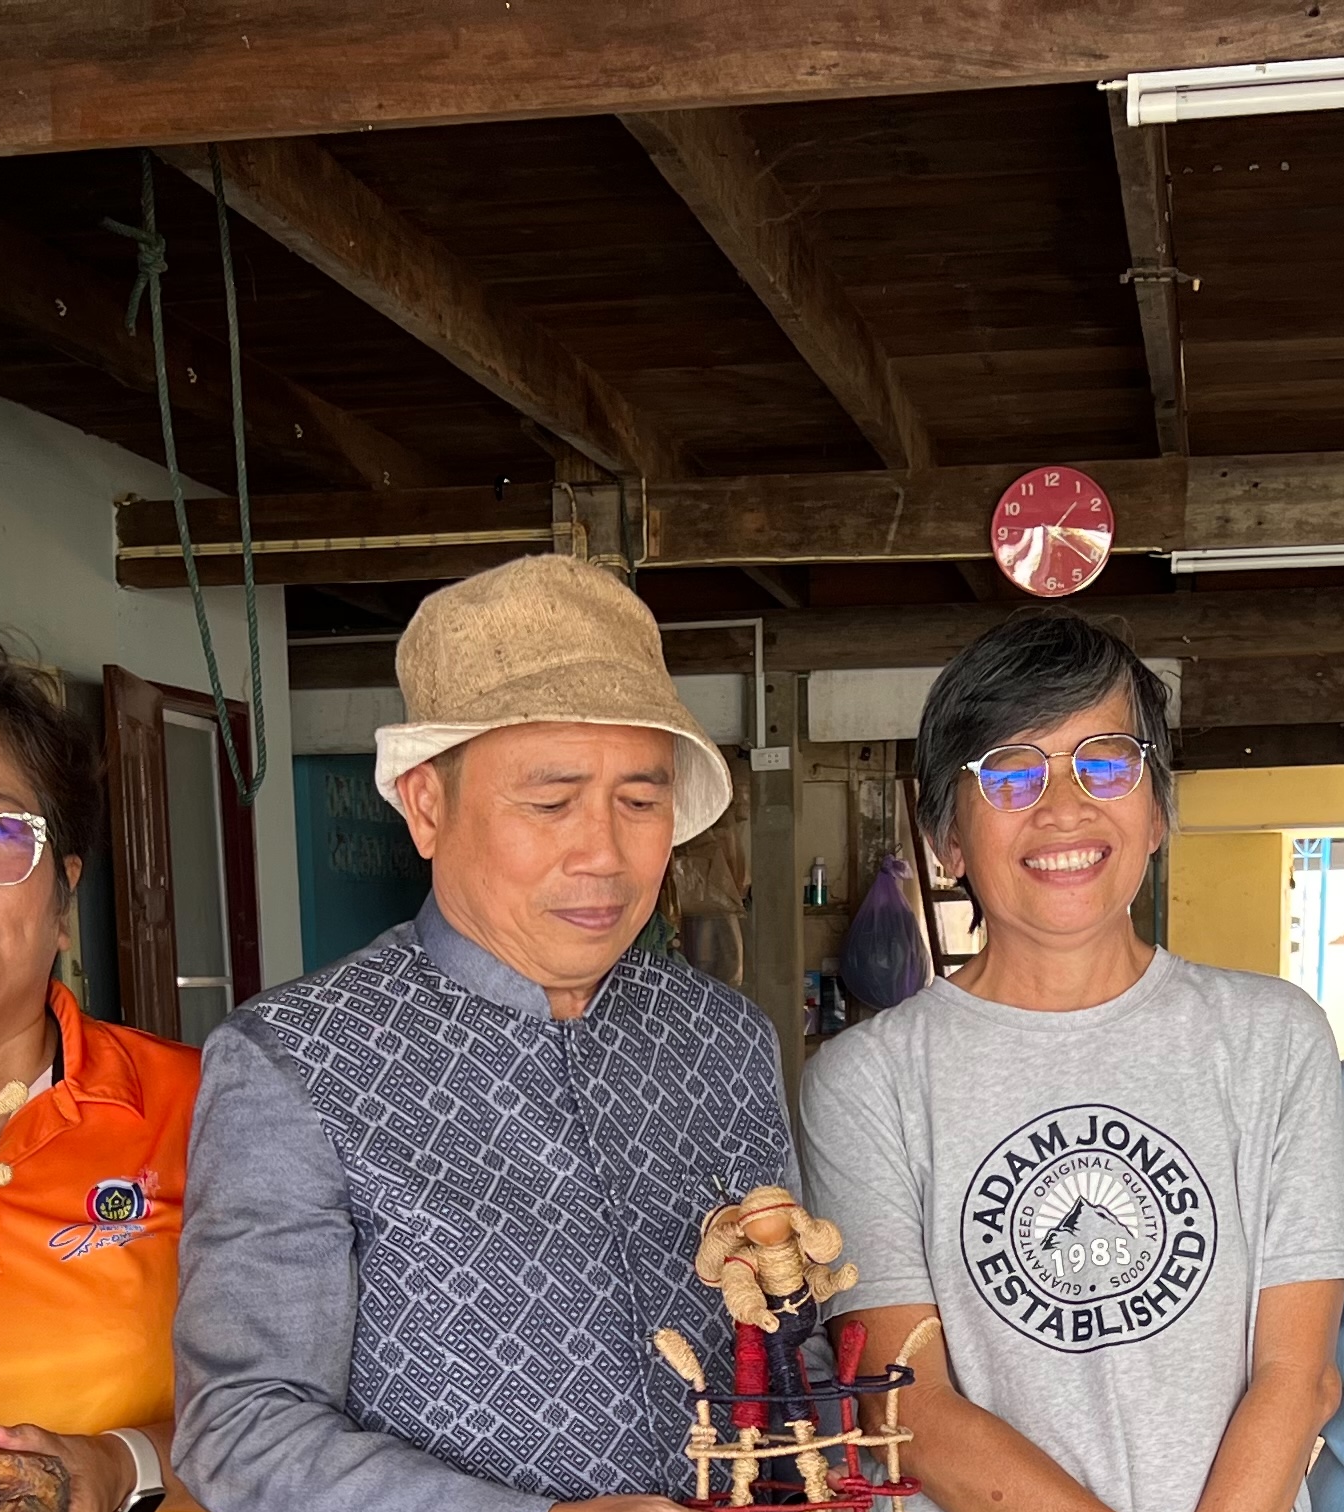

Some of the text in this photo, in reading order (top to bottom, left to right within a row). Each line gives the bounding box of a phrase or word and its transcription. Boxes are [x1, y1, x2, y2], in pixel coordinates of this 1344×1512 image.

[1044, 472, 1060, 487] 12
[1021, 483, 1034, 496] 11
[1075, 481, 1081, 494] 1
[1005, 502, 1020, 516] 10
[1090, 498, 1102, 512] 2
[997, 527, 1008, 541] 9
[1071, 568, 1083, 582] 5
[1046, 577, 1057, 590] 6
[972, 1115, 1200, 1234] ADAM JONES
[1018, 1156, 1159, 1297] GUARANTEED ORIGINAL QUALITY GOODS
[1050, 1236, 1132, 1278] 1985
[976, 1229, 1207, 1344] ESTABLISHED
